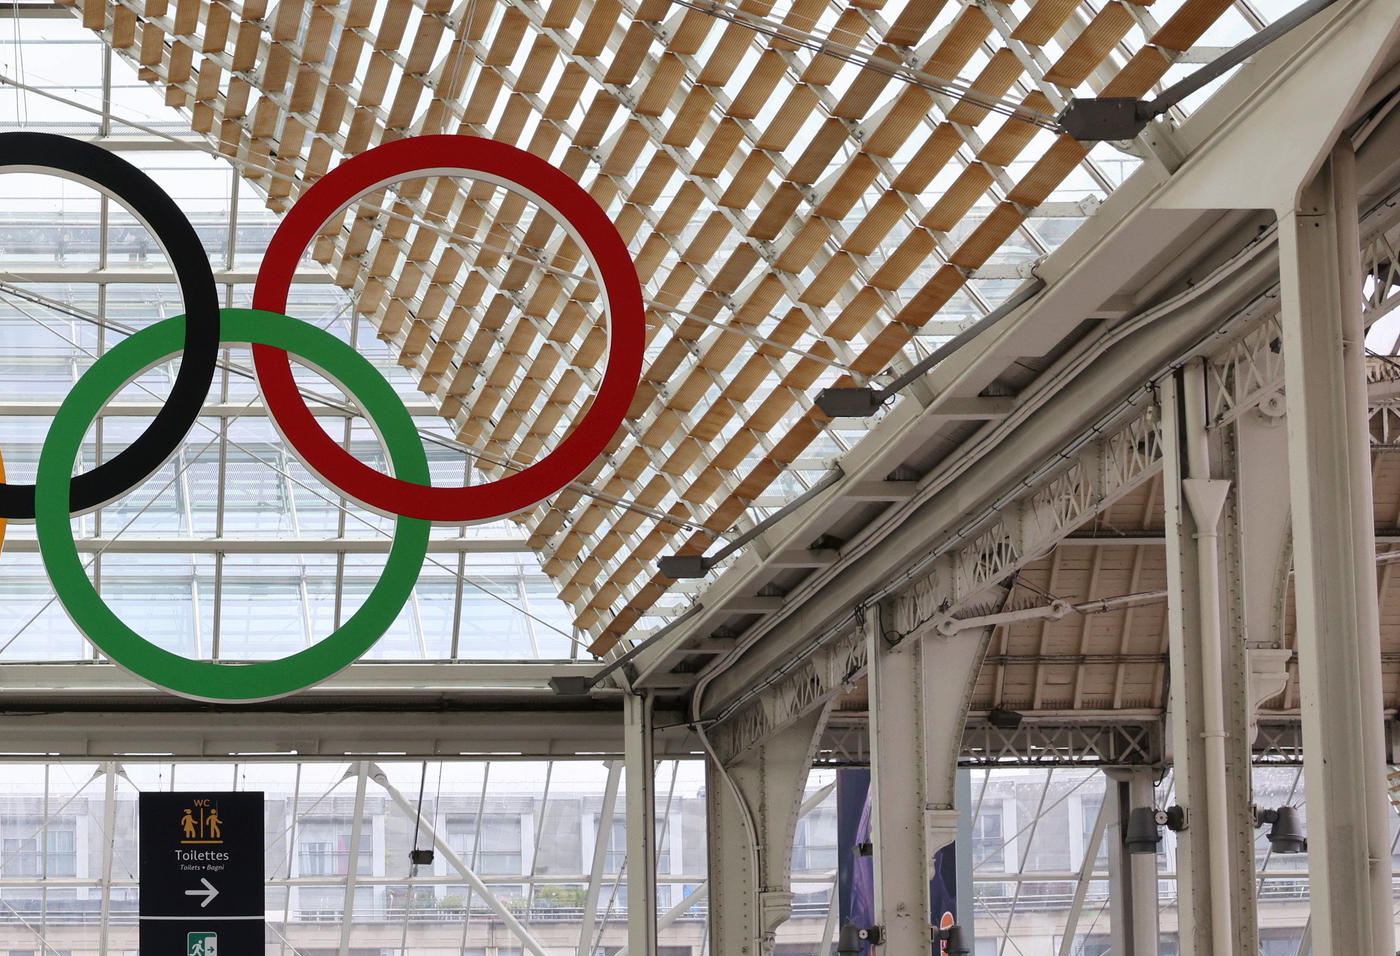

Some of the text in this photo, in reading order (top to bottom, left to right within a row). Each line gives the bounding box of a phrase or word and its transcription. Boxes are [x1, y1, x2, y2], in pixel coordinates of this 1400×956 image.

[194, 799, 210, 807] WC
[175, 850, 229, 861] Toilettes
[206, 864, 225, 872] Bagni
